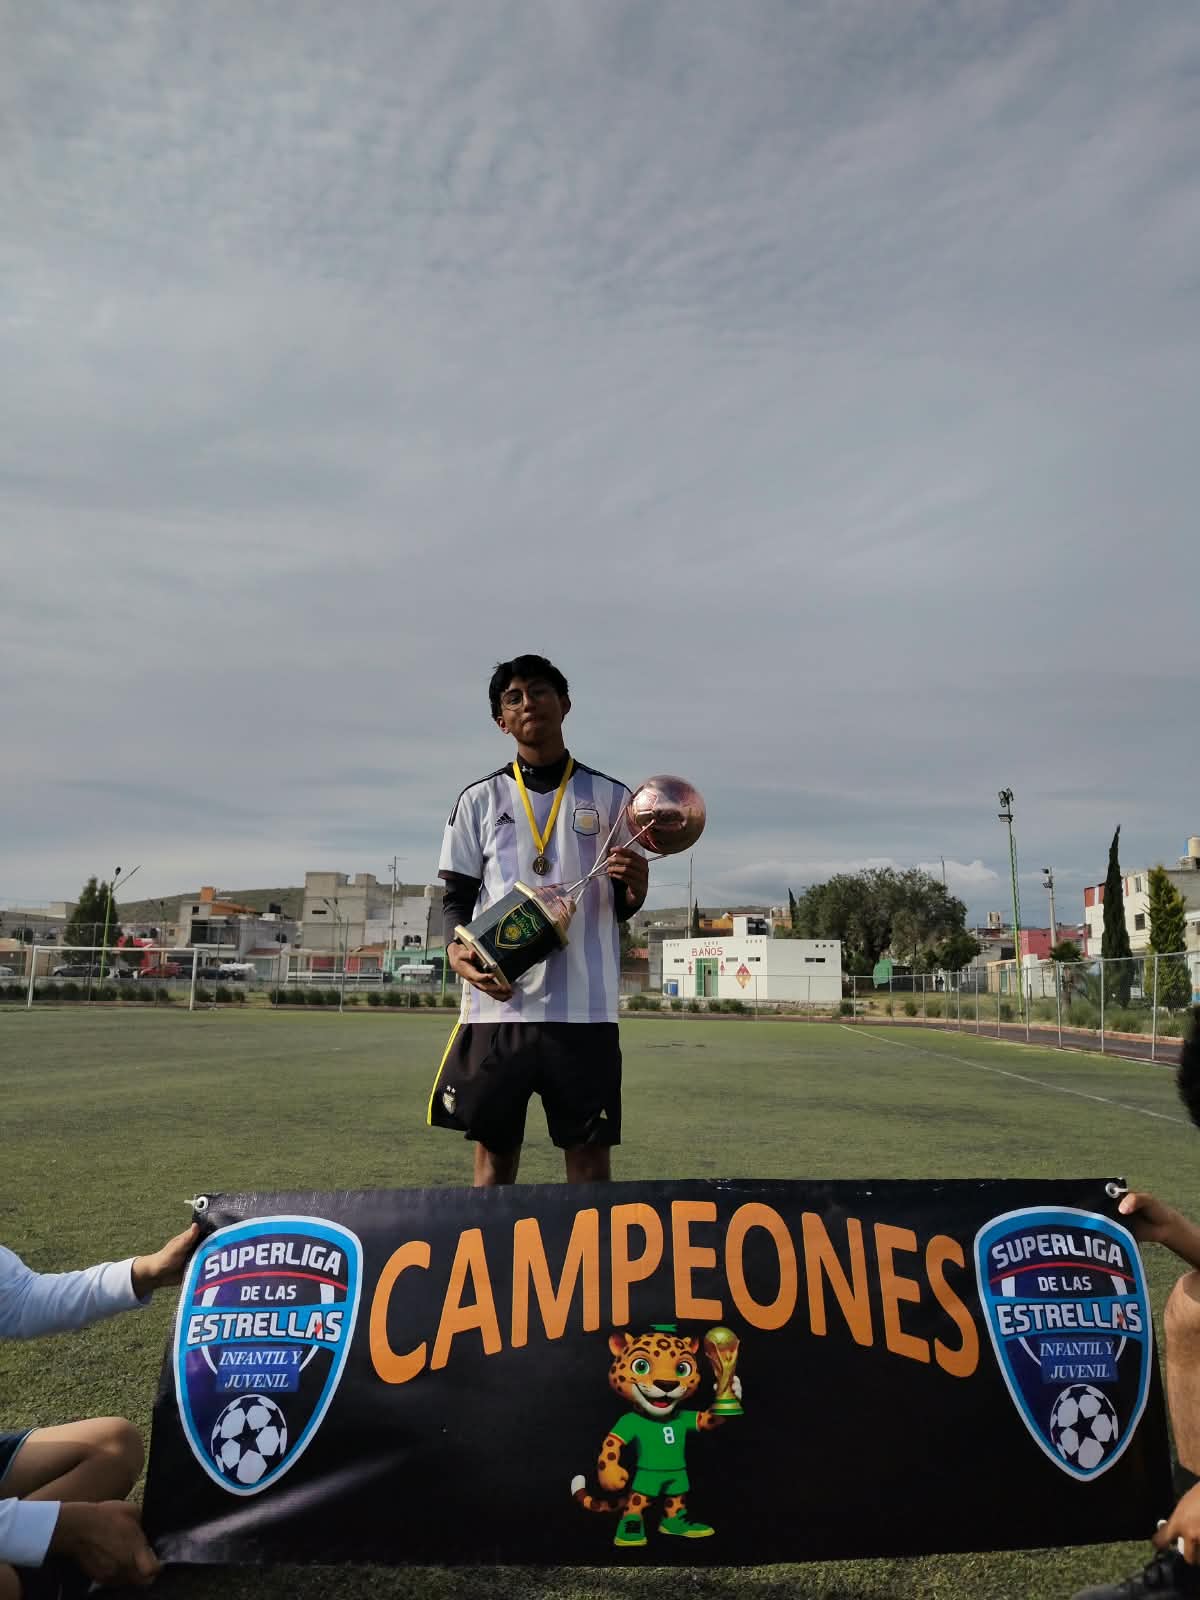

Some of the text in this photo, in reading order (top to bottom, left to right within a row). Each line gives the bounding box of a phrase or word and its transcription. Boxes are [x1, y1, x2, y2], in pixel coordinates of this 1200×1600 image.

[691, 945, 723, 956] BAÑOS
[991, 1233, 1124, 1269] SUPERLIGA
[204, 1241, 342, 1280] SUPERLIGA
[369, 1200, 980, 1384] CAMPEONES
[1038, 1276, 1092, 1292] DE LAS
[240, 1285, 297, 1301] DE LAS
[996, 1303, 1143, 1336] ESTRELLAS
[187, 1311, 343, 1345] ESTRELLAS
[1039, 1341, 1115, 1357] INFANTIL Y
[219, 1350, 303, 1366] INFANTIL Y
[1050, 1364, 1109, 1380] JUVENIL
[224, 1373, 289, 1388] JUVENIL
[662, 1426, 675, 1444] 8
